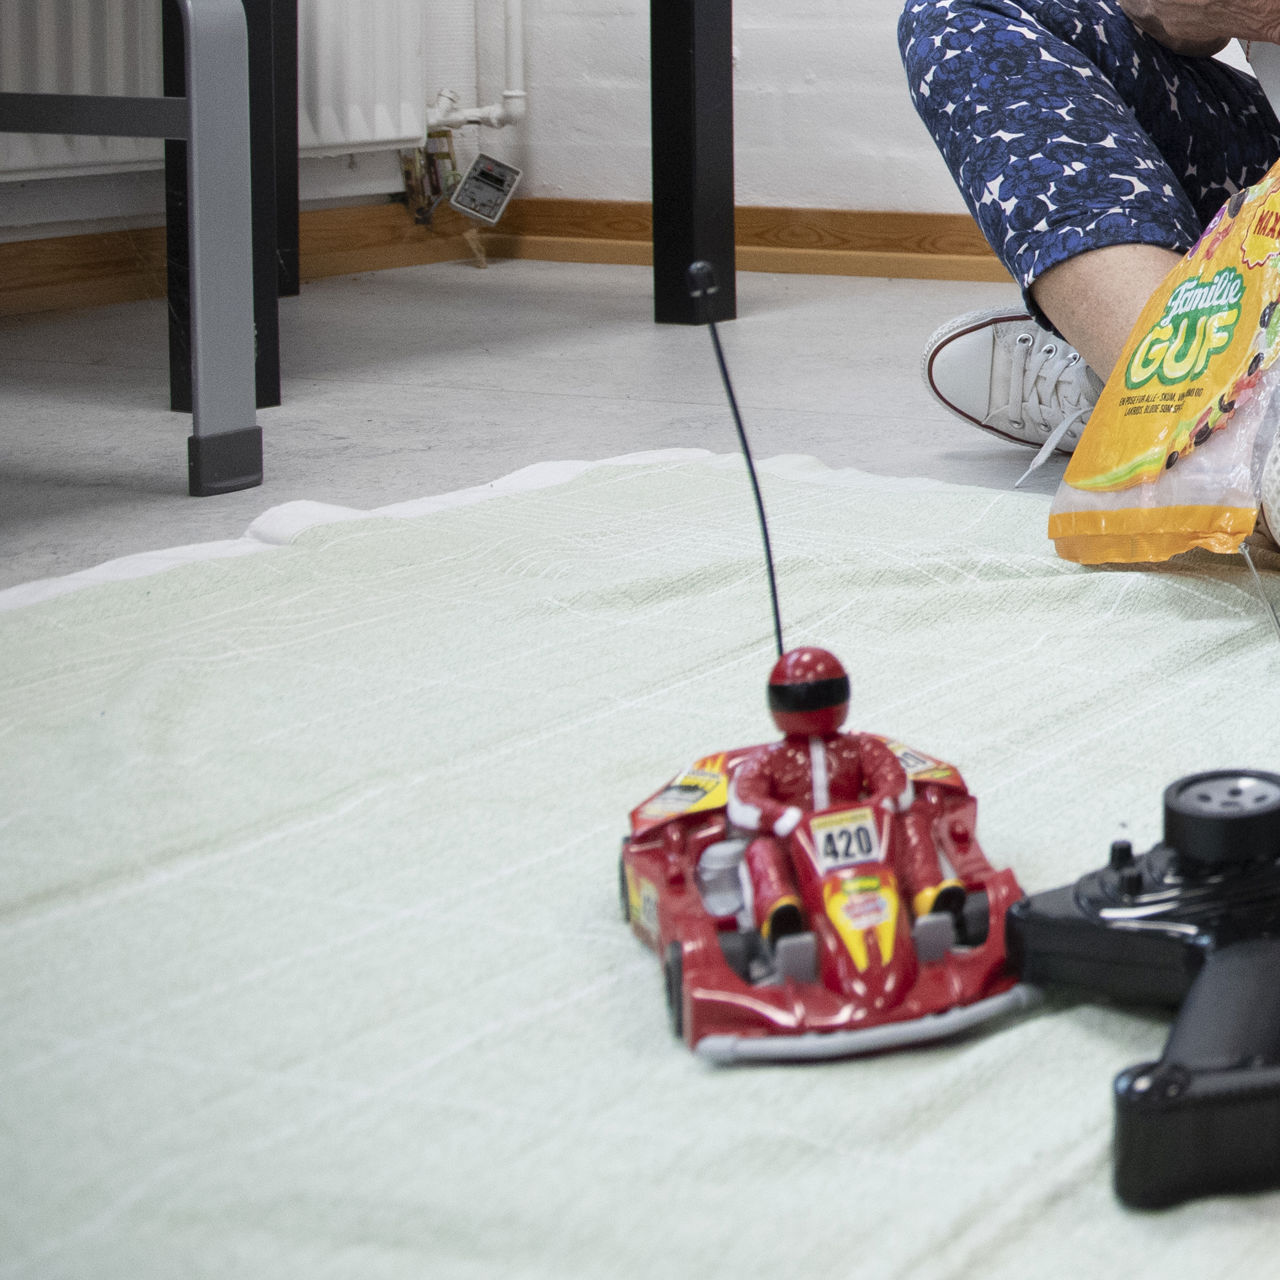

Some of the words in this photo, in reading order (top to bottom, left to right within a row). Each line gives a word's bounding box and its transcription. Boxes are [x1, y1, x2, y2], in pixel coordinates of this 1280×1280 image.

[1160, 271, 1242, 326] Familie
[1130, 309, 1239, 383] GUF
[823, 826, 873, 859] 420
